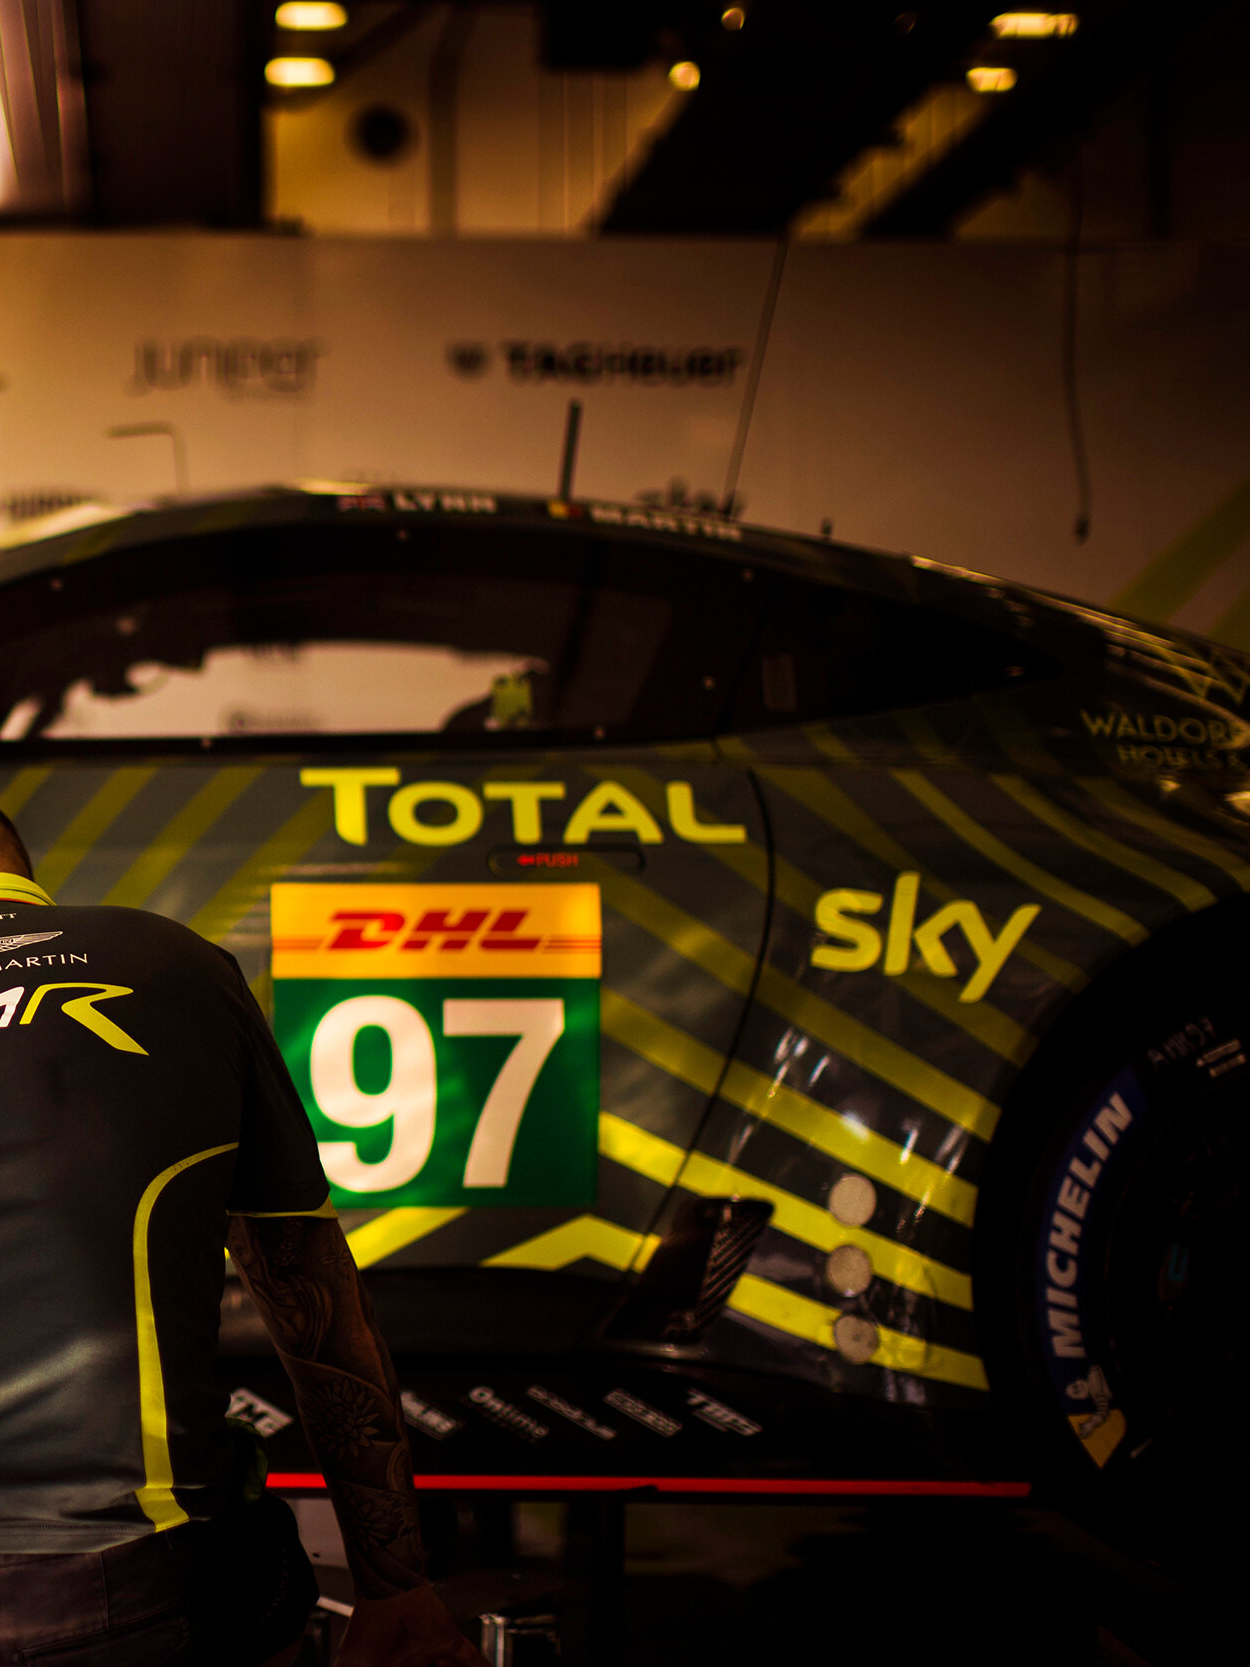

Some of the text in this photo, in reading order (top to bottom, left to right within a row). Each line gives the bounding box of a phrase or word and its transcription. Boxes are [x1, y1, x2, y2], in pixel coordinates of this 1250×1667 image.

[300, 767, 746, 846] TOTAL
[536, 852, 579, 868] PUSH
[326, 908, 544, 951] DHL
[310, 994, 565, 1192] 97
[1046, 1091, 1134, 1358] MICHELIN
